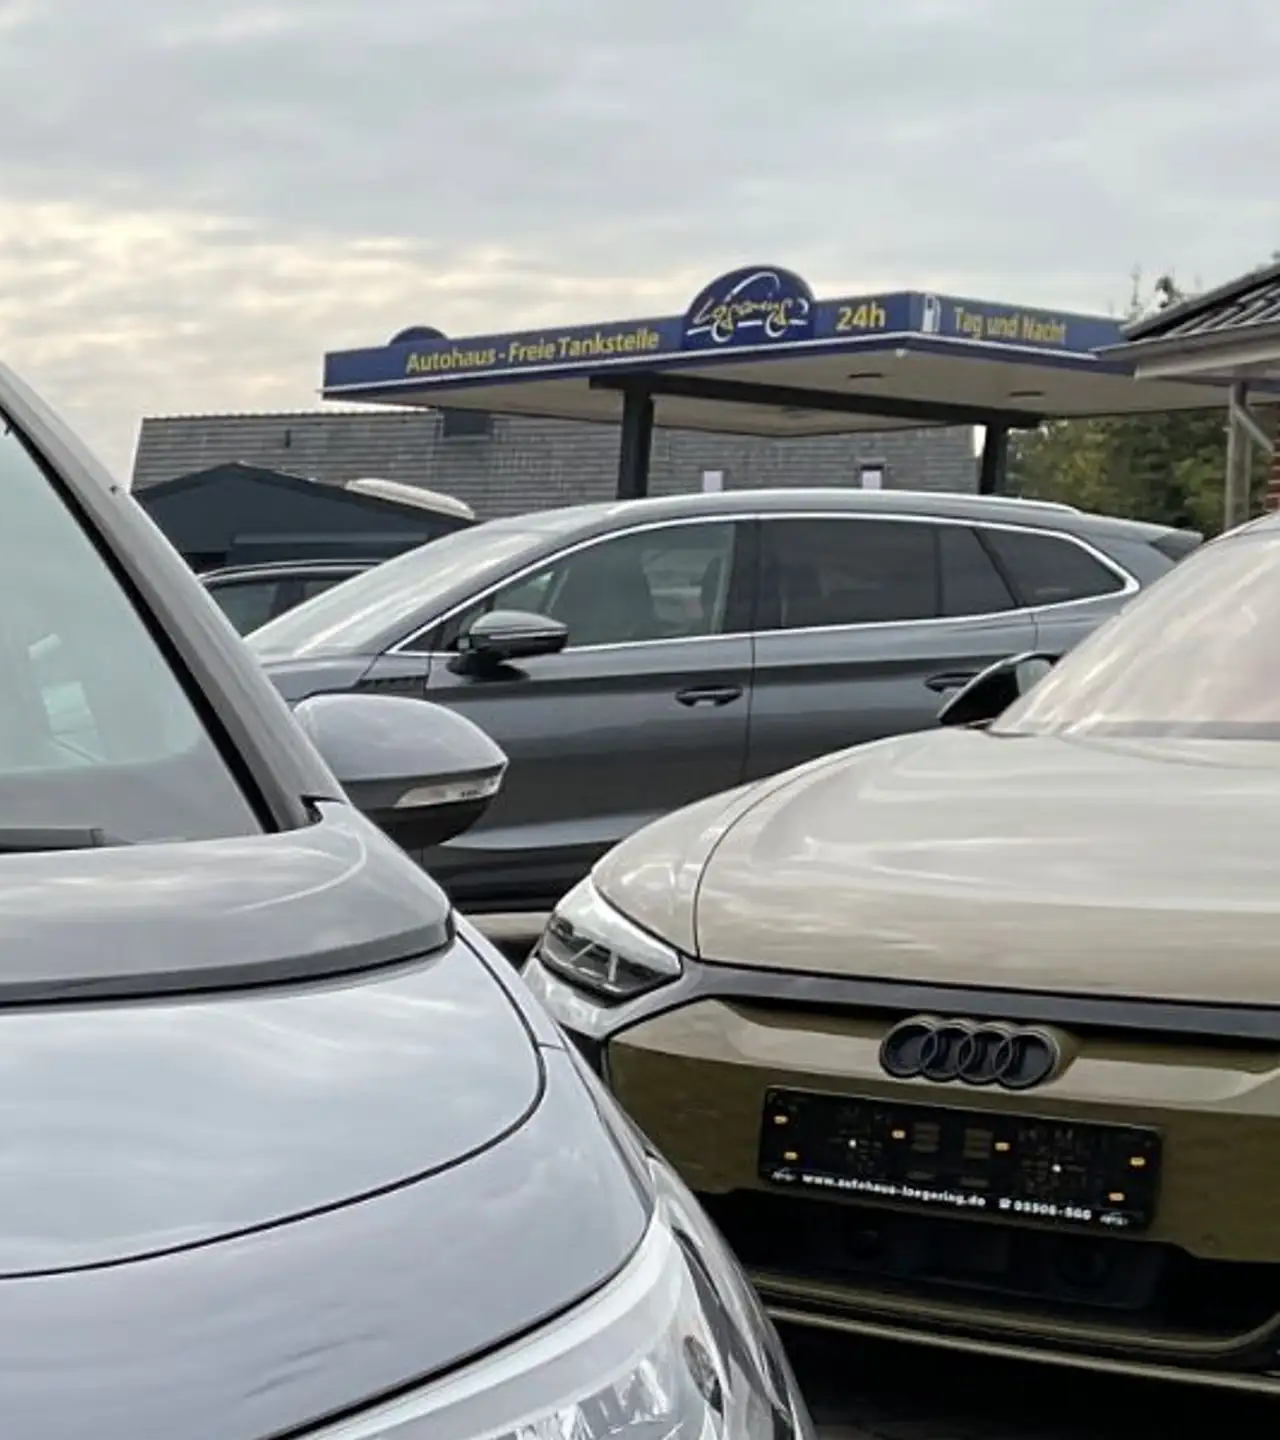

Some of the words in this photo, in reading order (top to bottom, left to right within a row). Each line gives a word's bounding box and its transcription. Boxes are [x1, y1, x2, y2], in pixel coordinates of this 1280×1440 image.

[836, 302, 886, 331] 24h
[954, 306, 984, 340] Tag
[987, 311, 1020, 338] und
[1022, 314, 1068, 345] Nacht
[406, 347, 497, 373] Autohaus
[508, 337, 554, 363] Freie
[559, 328, 660, 357] Tankstelle
